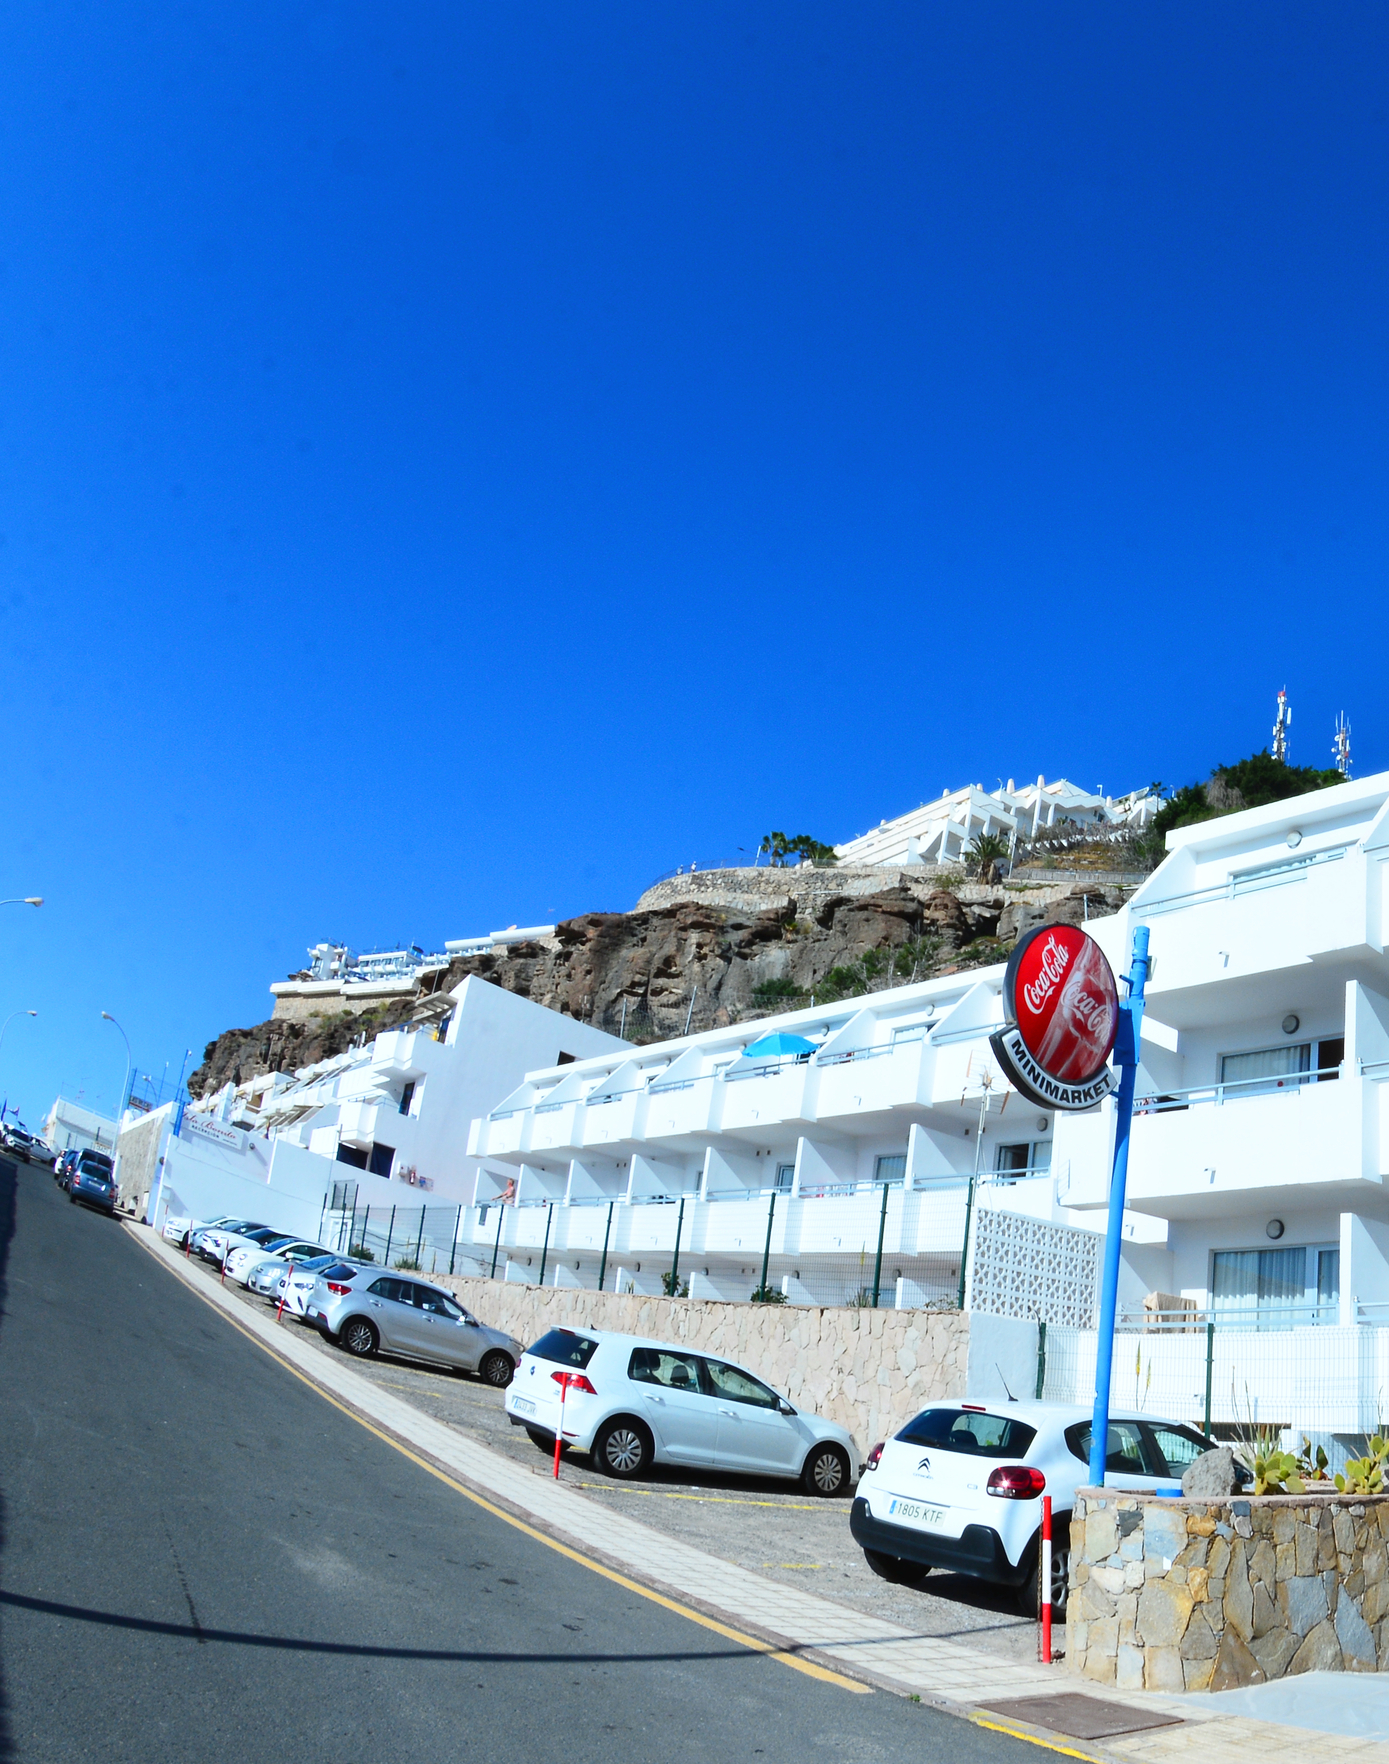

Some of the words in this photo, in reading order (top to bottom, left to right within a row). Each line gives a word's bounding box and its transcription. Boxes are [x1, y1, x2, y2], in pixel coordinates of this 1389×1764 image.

[1023, 933, 1069, 1015] Coca-Cola
[1011, 1038, 1112, 1104] MINIMARKET
[200, 1120, 237, 1139] Bonita
[897, 1503, 920, 1519] 1805
[921, 1508, 943, 1523] KTF
